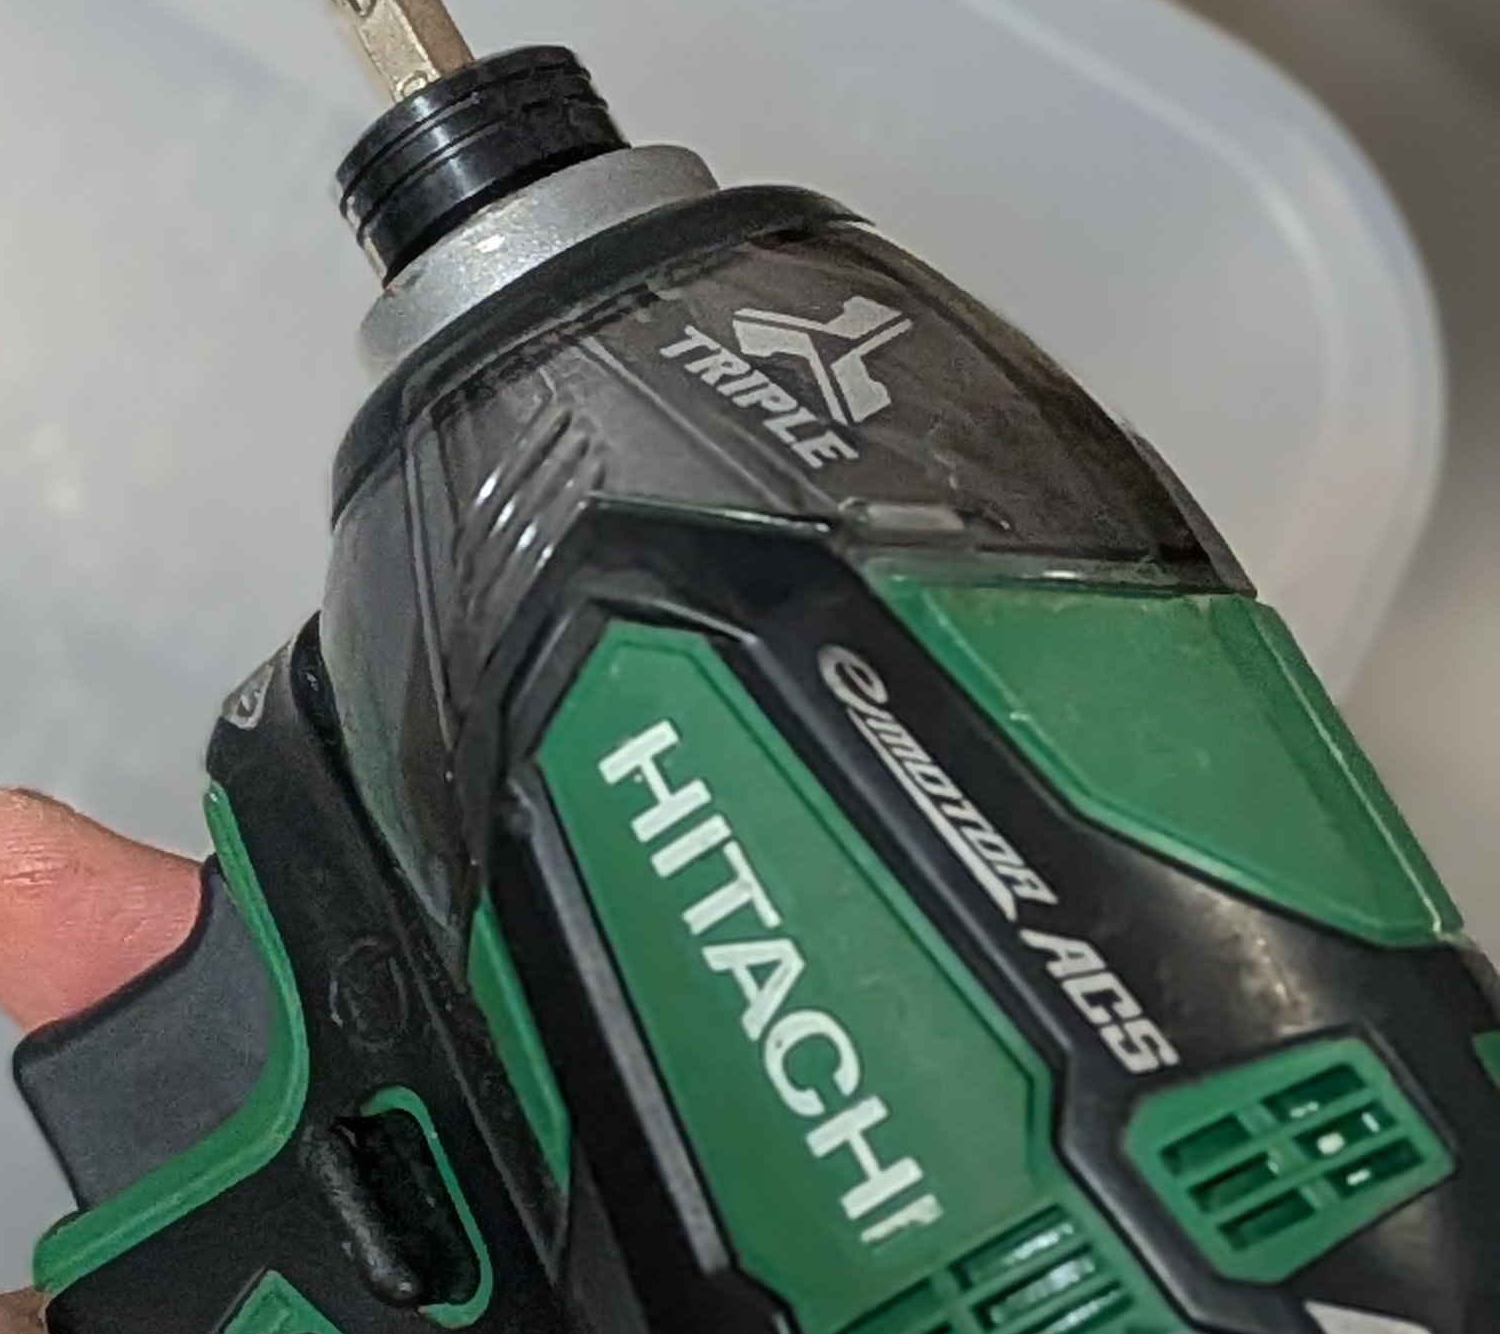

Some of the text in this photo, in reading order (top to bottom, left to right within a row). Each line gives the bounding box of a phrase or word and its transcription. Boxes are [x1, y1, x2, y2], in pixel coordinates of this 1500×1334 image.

[659, 324, 860, 468] TRIPLE
[598, 719, 944, 1244] HITACHI
[1019, 928, 1179, 1074] ACS
